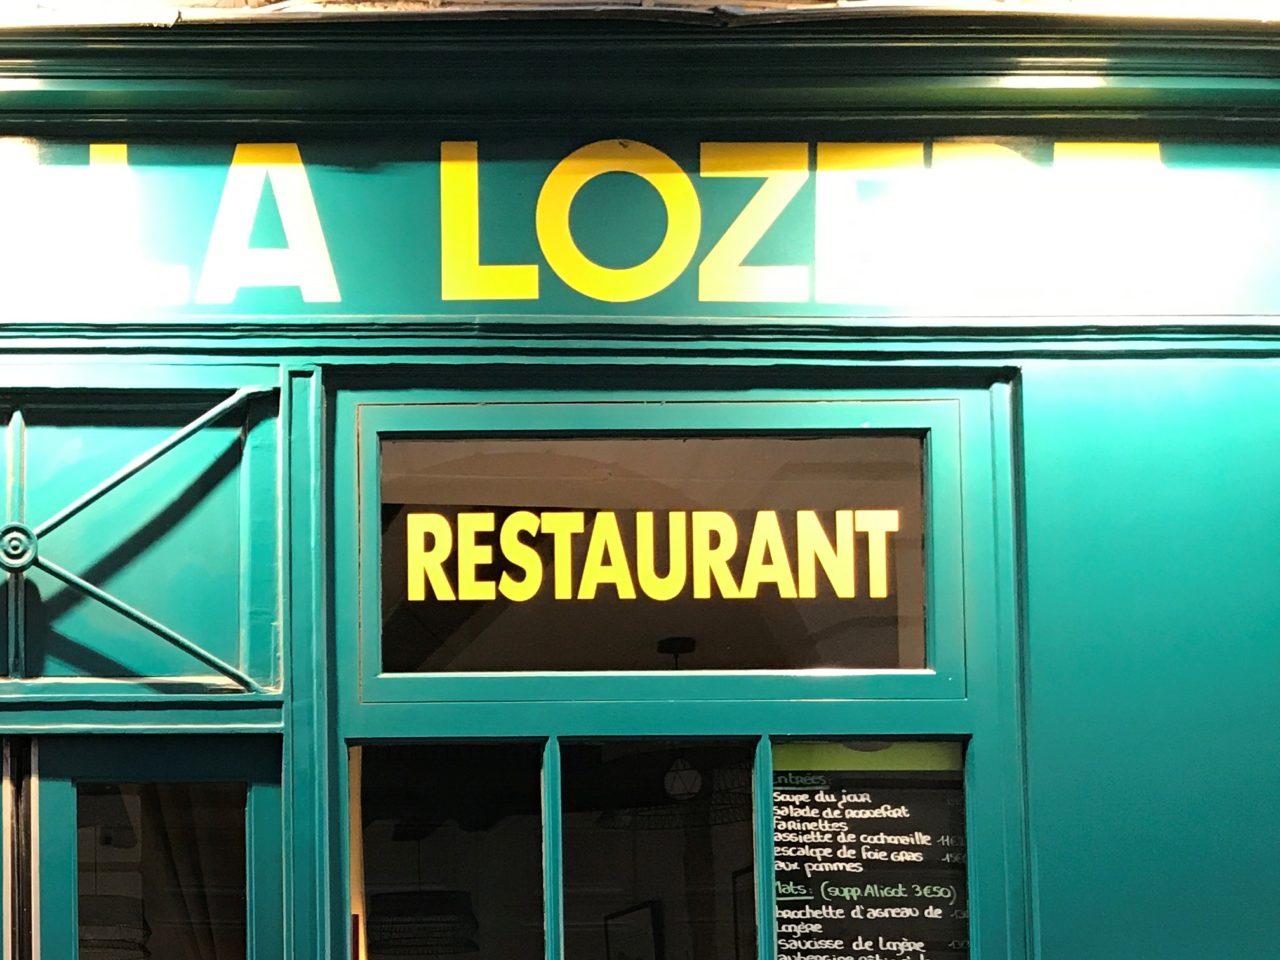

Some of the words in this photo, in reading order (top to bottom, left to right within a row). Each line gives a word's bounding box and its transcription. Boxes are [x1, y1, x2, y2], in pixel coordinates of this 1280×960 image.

[406, 510, 900, 602] RESTAURANT
[815, 790, 837, 802] du
[822, 807, 843, 819] de
[836, 831, 857, 843] de
[836, 844, 857, 859] de
[861, 845, 889, 861] foie
[775, 860, 800, 871] aux
[804, 862, 864, 878] pommes
[923, 905, 943, 919] de
[852, 935, 874, 951] de
